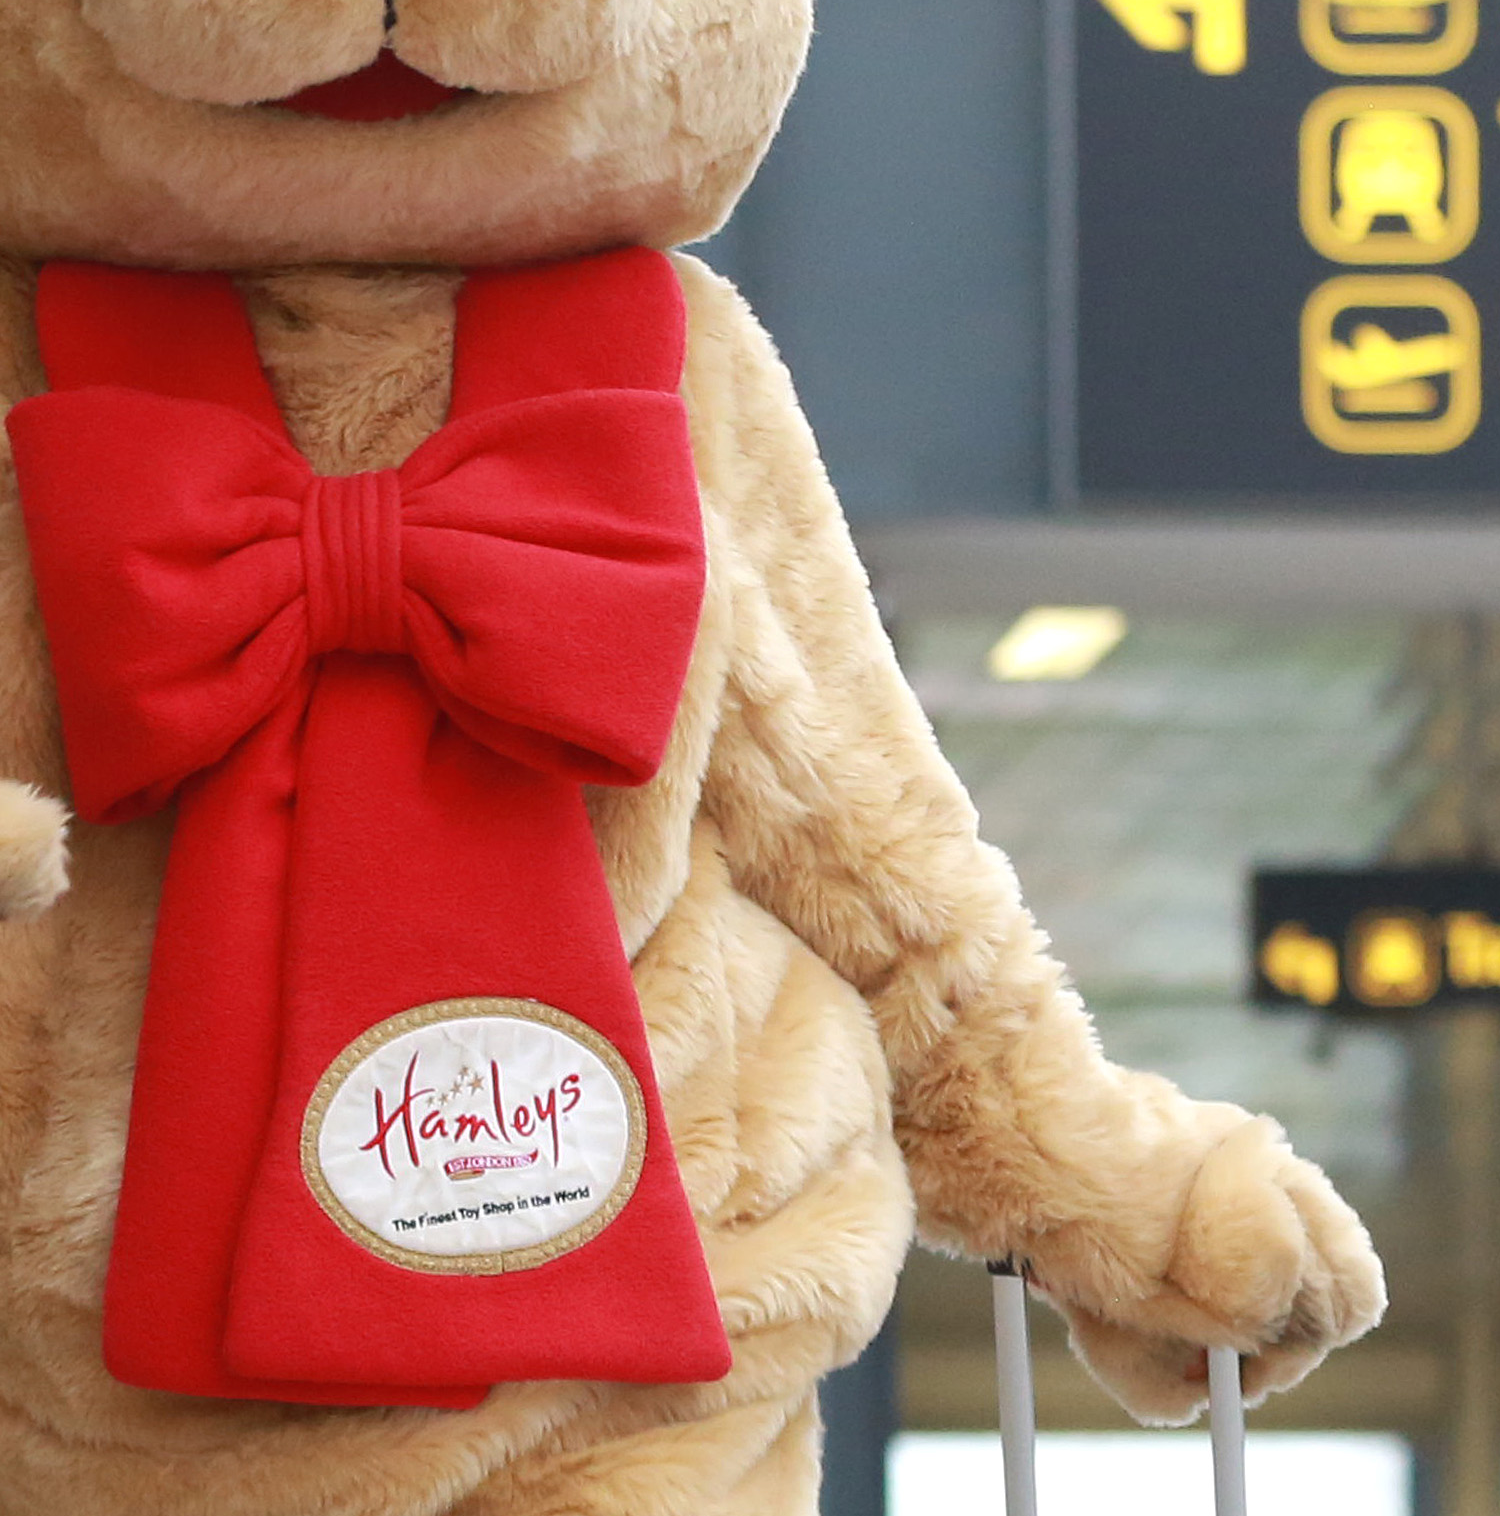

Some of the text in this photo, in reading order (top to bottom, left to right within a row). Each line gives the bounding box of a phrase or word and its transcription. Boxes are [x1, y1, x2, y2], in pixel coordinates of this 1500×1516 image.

[358, 1050, 582, 1179] Hamleys
[392, 1185, 591, 1233] The Finest Toy Shop in the World
